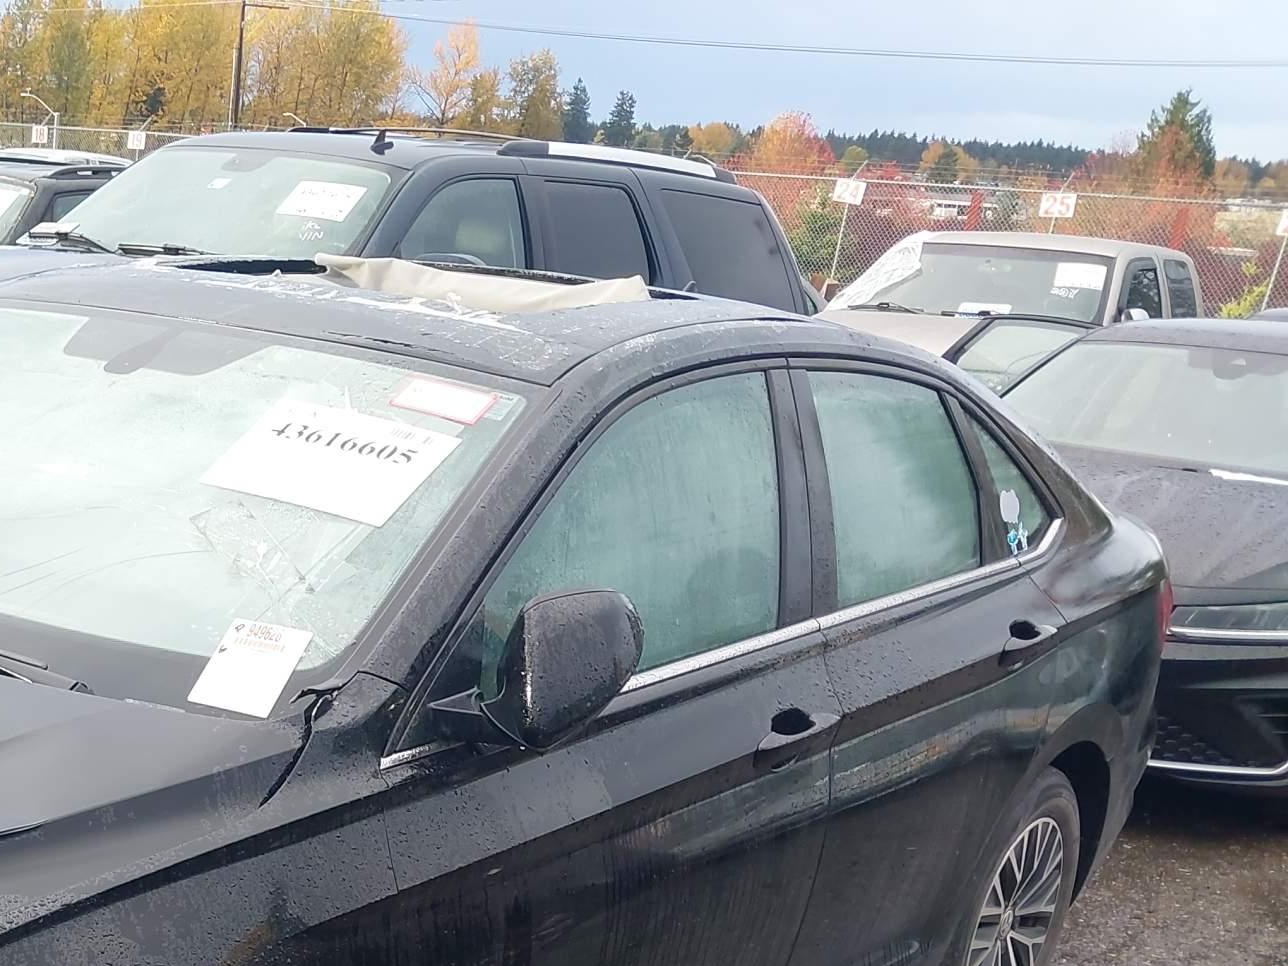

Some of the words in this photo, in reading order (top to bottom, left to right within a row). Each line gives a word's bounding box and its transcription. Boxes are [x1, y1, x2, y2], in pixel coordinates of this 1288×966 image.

[35, 127, 45, 142] 18
[132, 132, 143, 148] 19
[836, 182, 861, 203] 24
[1044, 195, 1073, 216] 25
[271, 422, 418, 464] 43616605
